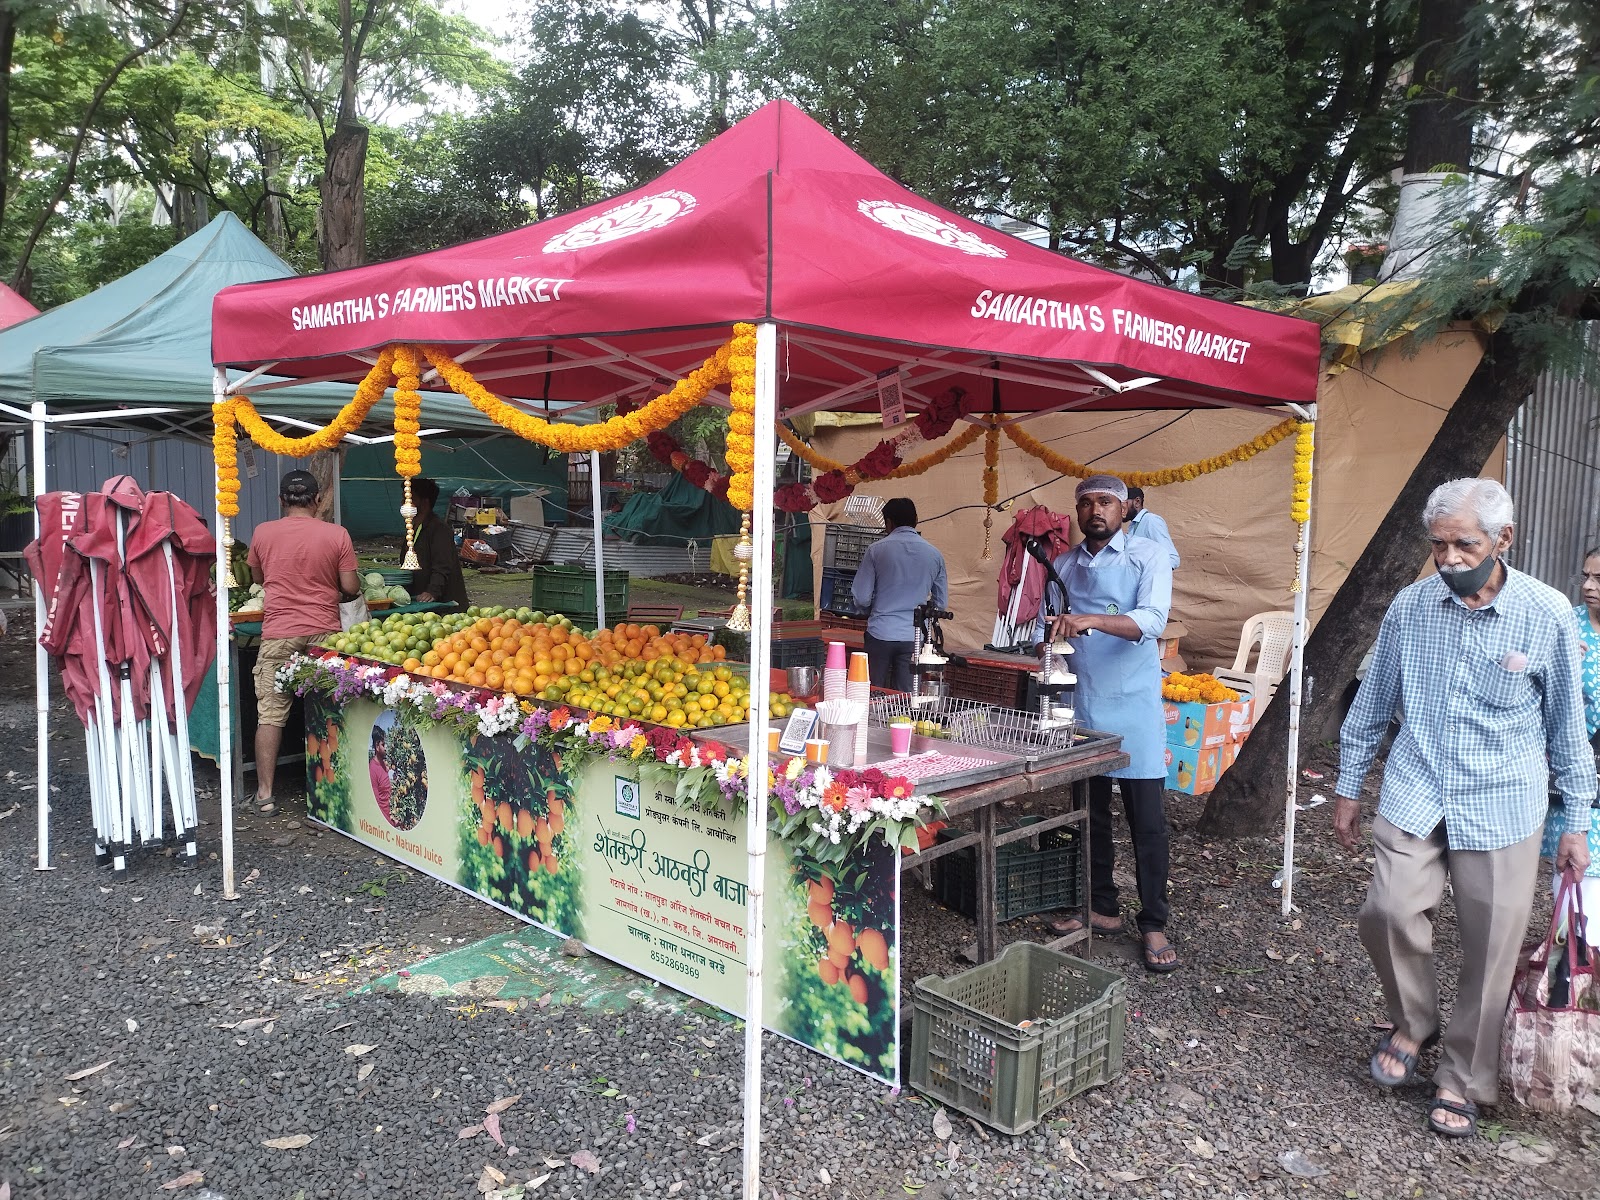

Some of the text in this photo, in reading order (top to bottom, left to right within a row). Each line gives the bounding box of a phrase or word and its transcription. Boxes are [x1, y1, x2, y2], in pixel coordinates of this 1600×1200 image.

[291, 276, 573, 331] SAMARTHA'S FARMERS MARKET
[970, 289, 1251, 366] SAMARTHA'S FARMERS MARKET
[359, 819, 385, 840] Vitamin
[386, 831, 391, 843] C
[396, 834, 423, 856] Natural
[424, 846, 442, 866] Juice
[672, 814, 690, 830] कंपनी
[706, 827, 737, 844] आयोजित
[593, 828, 748, 906] शेतकरी आठवडी बाजा
[610, 878, 626, 890] गटाचे
[644, 890, 668, 908] सातपुडा
[689, 904, 712, 923] शेतकरी
[714, 917, 731, 931] बचत
[627, 924, 652, 943] चालक
[659, 938, 678, 955] सागर
[680, 947, 706, 966] धनराज
[708, 956, 726, 974] बरडे
[650, 949, 700, 980] 8552869369
